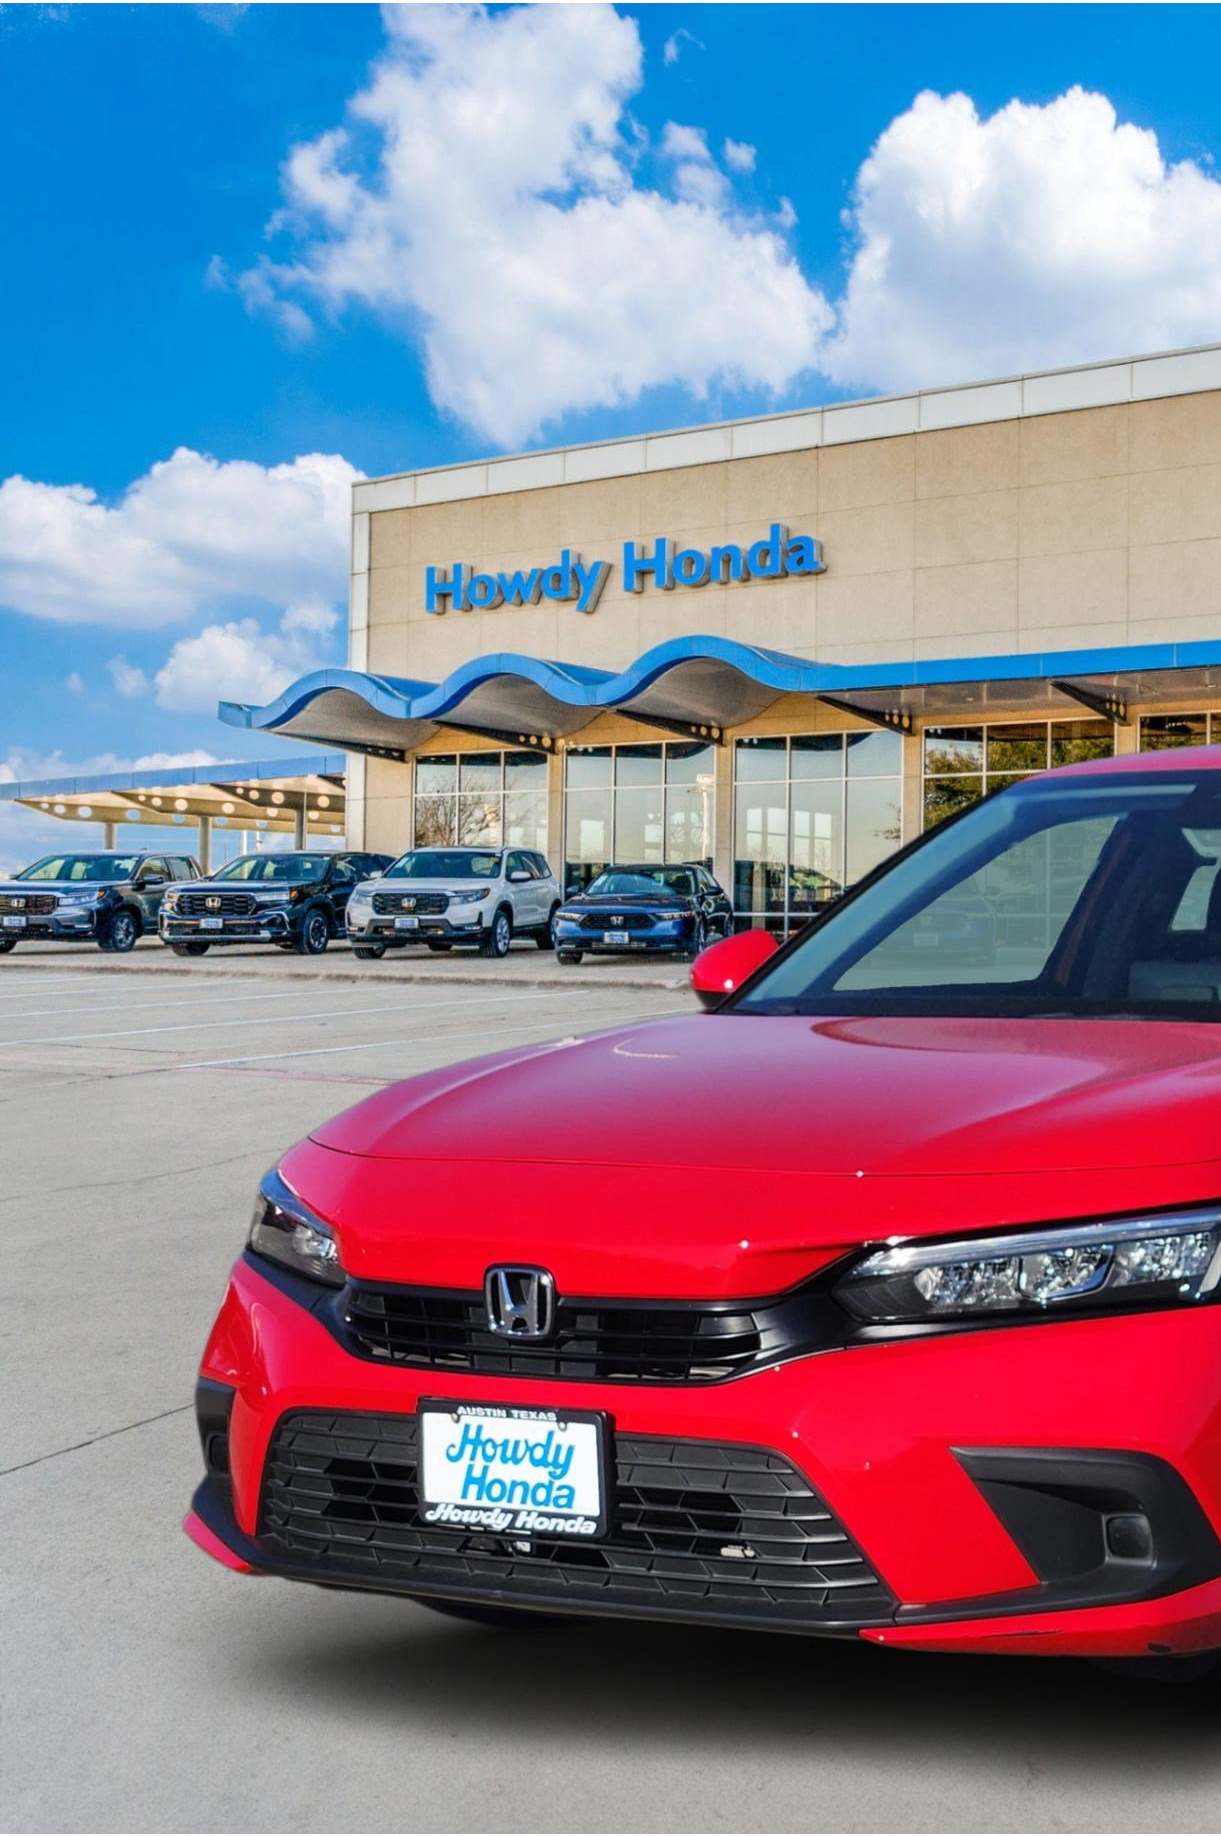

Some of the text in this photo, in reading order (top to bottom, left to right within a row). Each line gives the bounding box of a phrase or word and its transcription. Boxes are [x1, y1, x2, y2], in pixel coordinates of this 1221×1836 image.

[425, 523, 827, 615] Howdy Honda
[456, 1406, 557, 1421] AUSTIN TEXAS
[446, 1423, 575, 1480] Howdy
[461, 1464, 576, 1509] Honda
[425, 1503, 597, 1535] Howdy Honda
